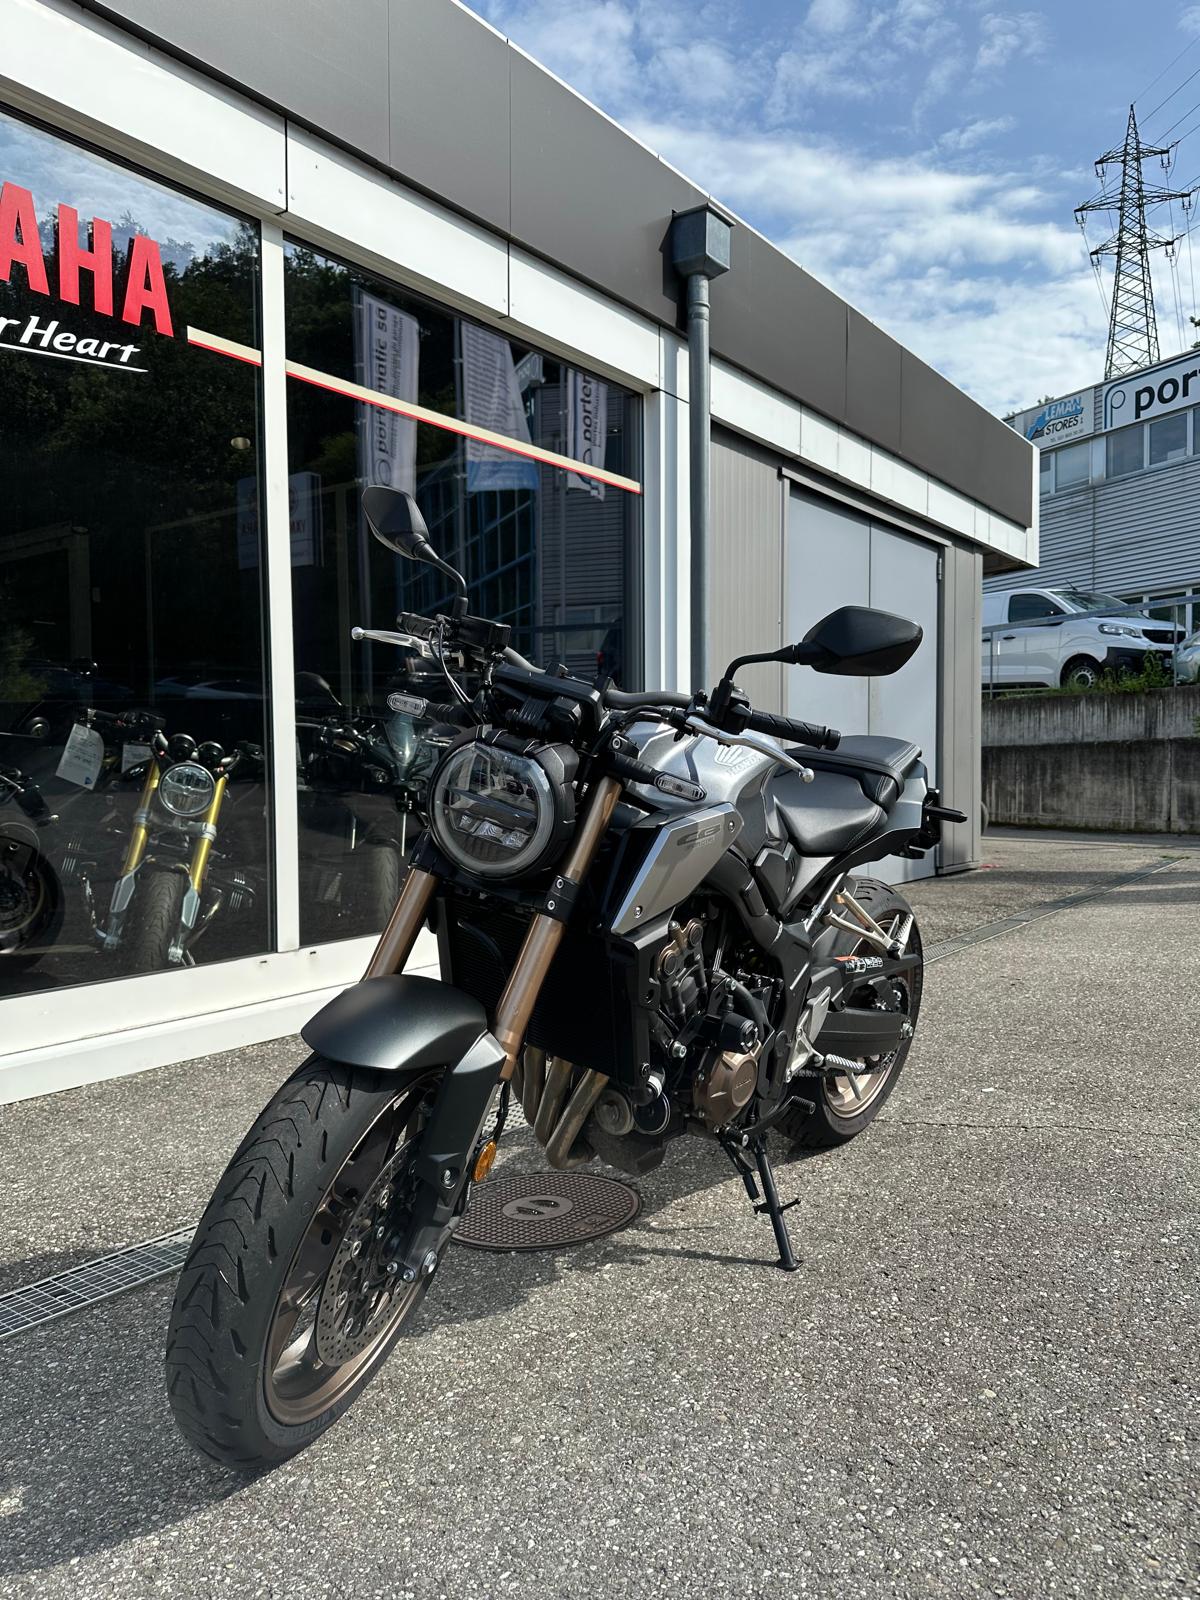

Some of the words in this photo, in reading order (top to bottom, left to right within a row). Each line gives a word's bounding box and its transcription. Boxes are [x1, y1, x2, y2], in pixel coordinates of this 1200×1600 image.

[0, 181, 174, 338] AHA
[20, 315, 141, 363] Heart
[1135, 368, 1200, 420] por
[1045, 415, 1079, 436] STORES
